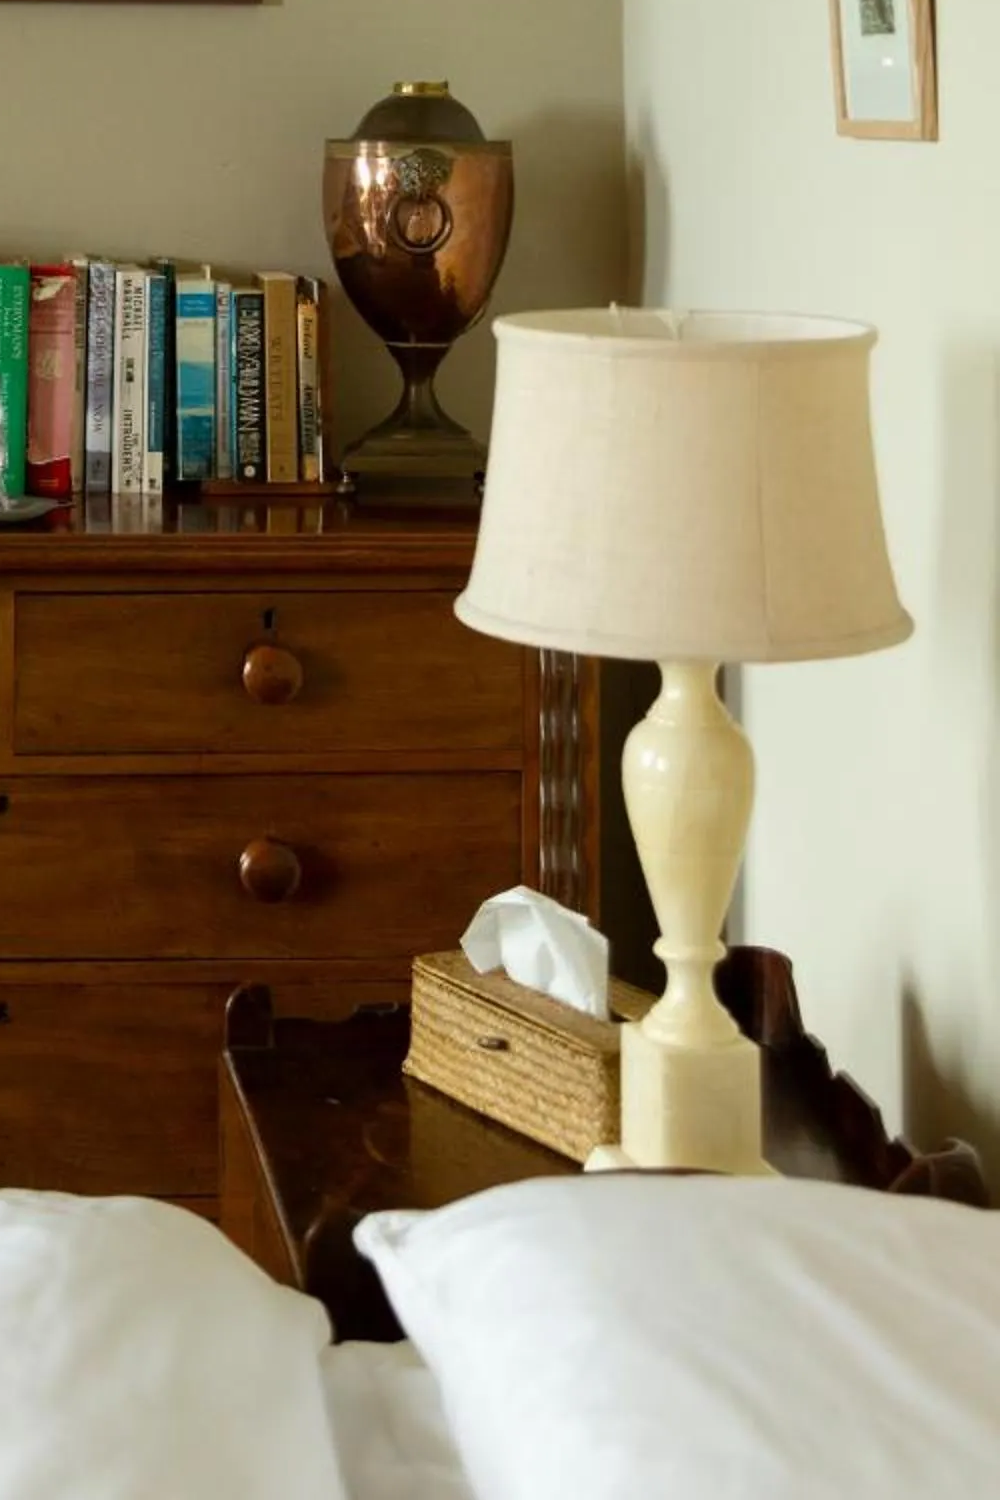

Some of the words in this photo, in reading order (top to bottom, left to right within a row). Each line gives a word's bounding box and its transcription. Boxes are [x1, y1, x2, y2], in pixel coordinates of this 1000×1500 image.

[122, 279, 133, 340] MARSHALL
[133, 286, 144, 331] MICHAEL
[121, 409, 133, 473] INTRUDERS
